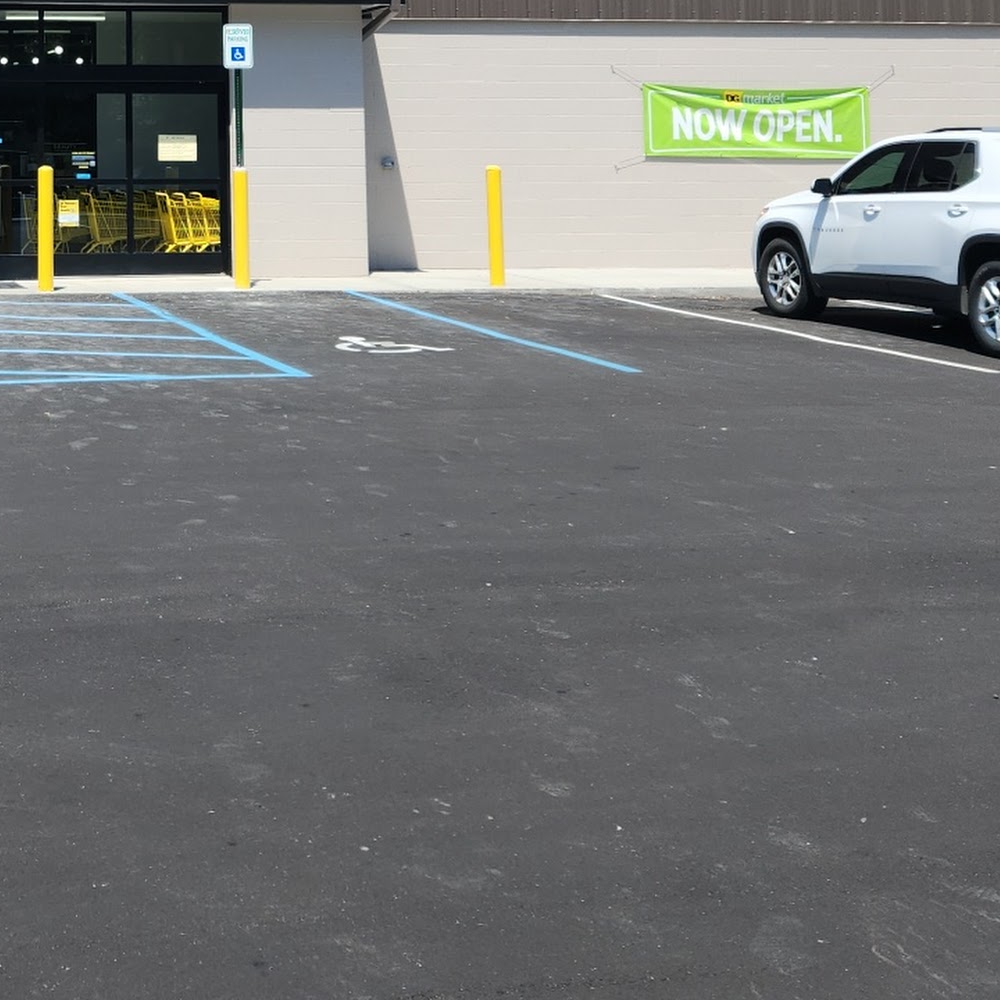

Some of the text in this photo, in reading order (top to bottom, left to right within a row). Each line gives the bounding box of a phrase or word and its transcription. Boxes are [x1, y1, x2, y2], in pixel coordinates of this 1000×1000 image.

[725, 92, 785, 104] DG market
[672, 106, 843, 143] NOW OPEN.
